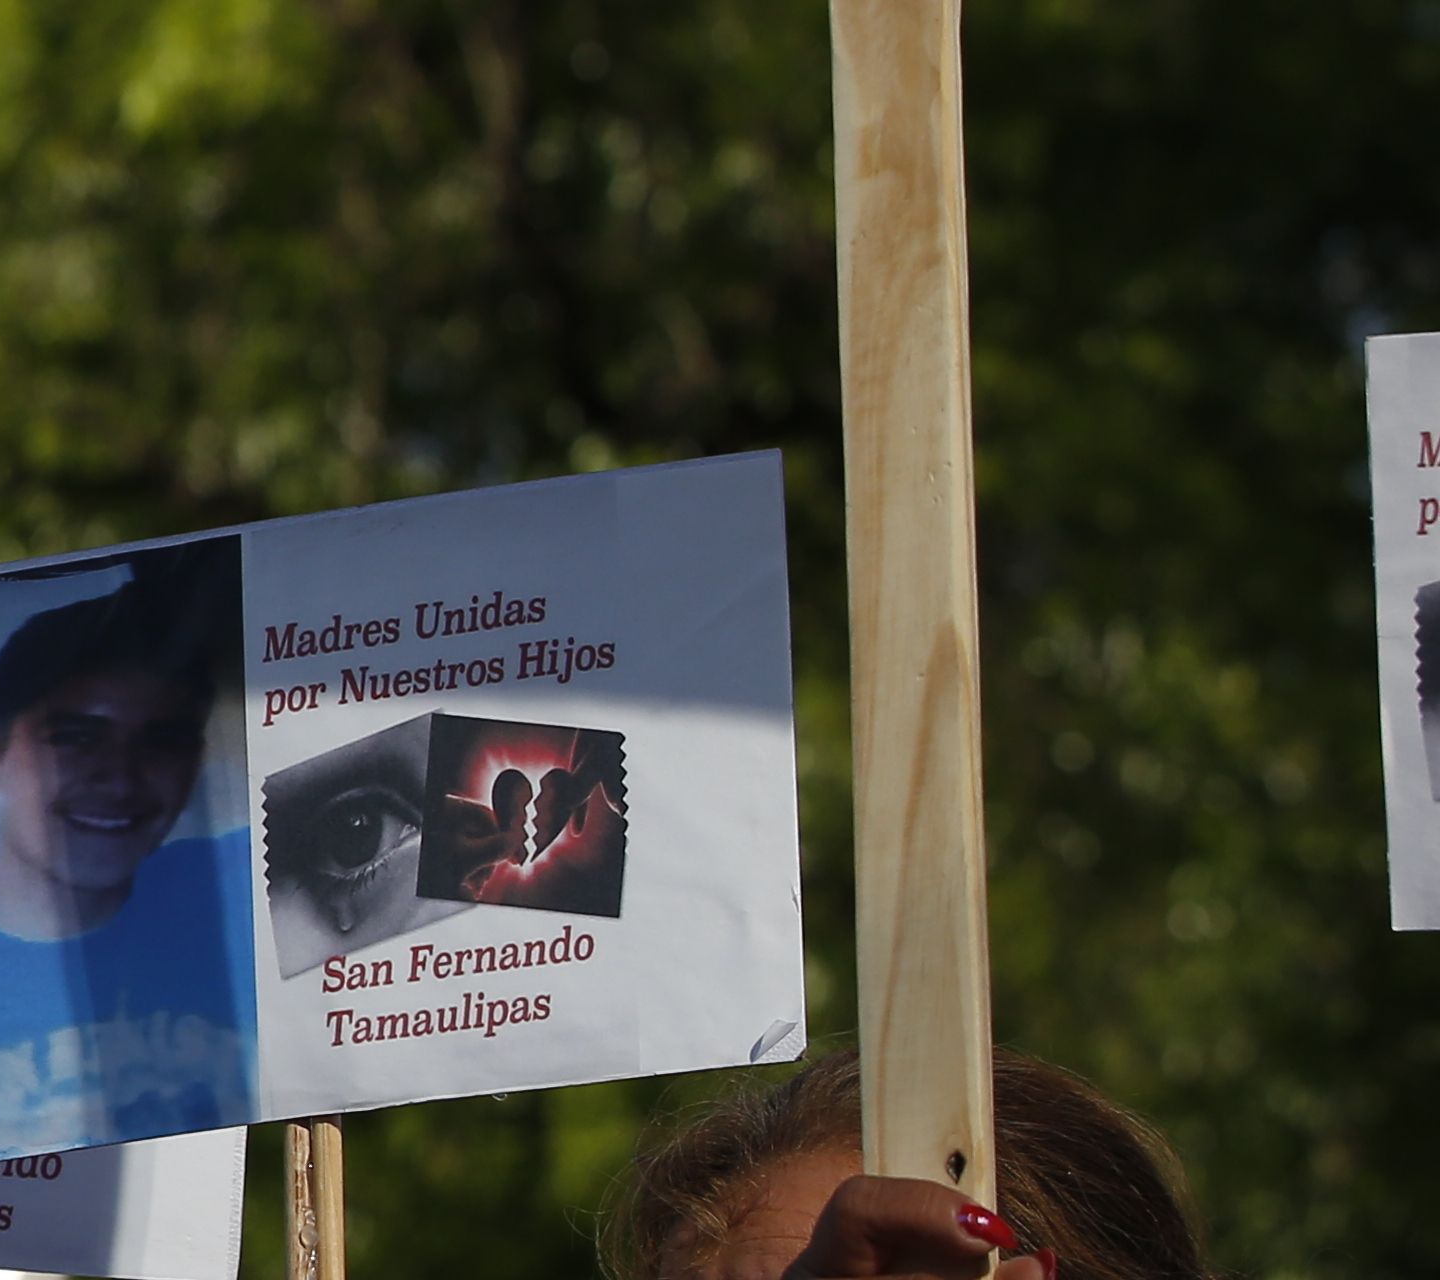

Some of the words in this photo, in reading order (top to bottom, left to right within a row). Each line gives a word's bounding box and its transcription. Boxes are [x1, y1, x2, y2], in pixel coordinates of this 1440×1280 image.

[262, 615, 401, 664] Madres
[414, 591, 547, 640] Unidas
[262, 680, 327, 727] por
[337, 655, 505, 705] Nuestros
[516, 636, 616, 684] Hijos
[322, 955, 394, 993] San
[407, 924, 595, 983] Fernando
[326, 991, 552, 1048] Tamaulipas
